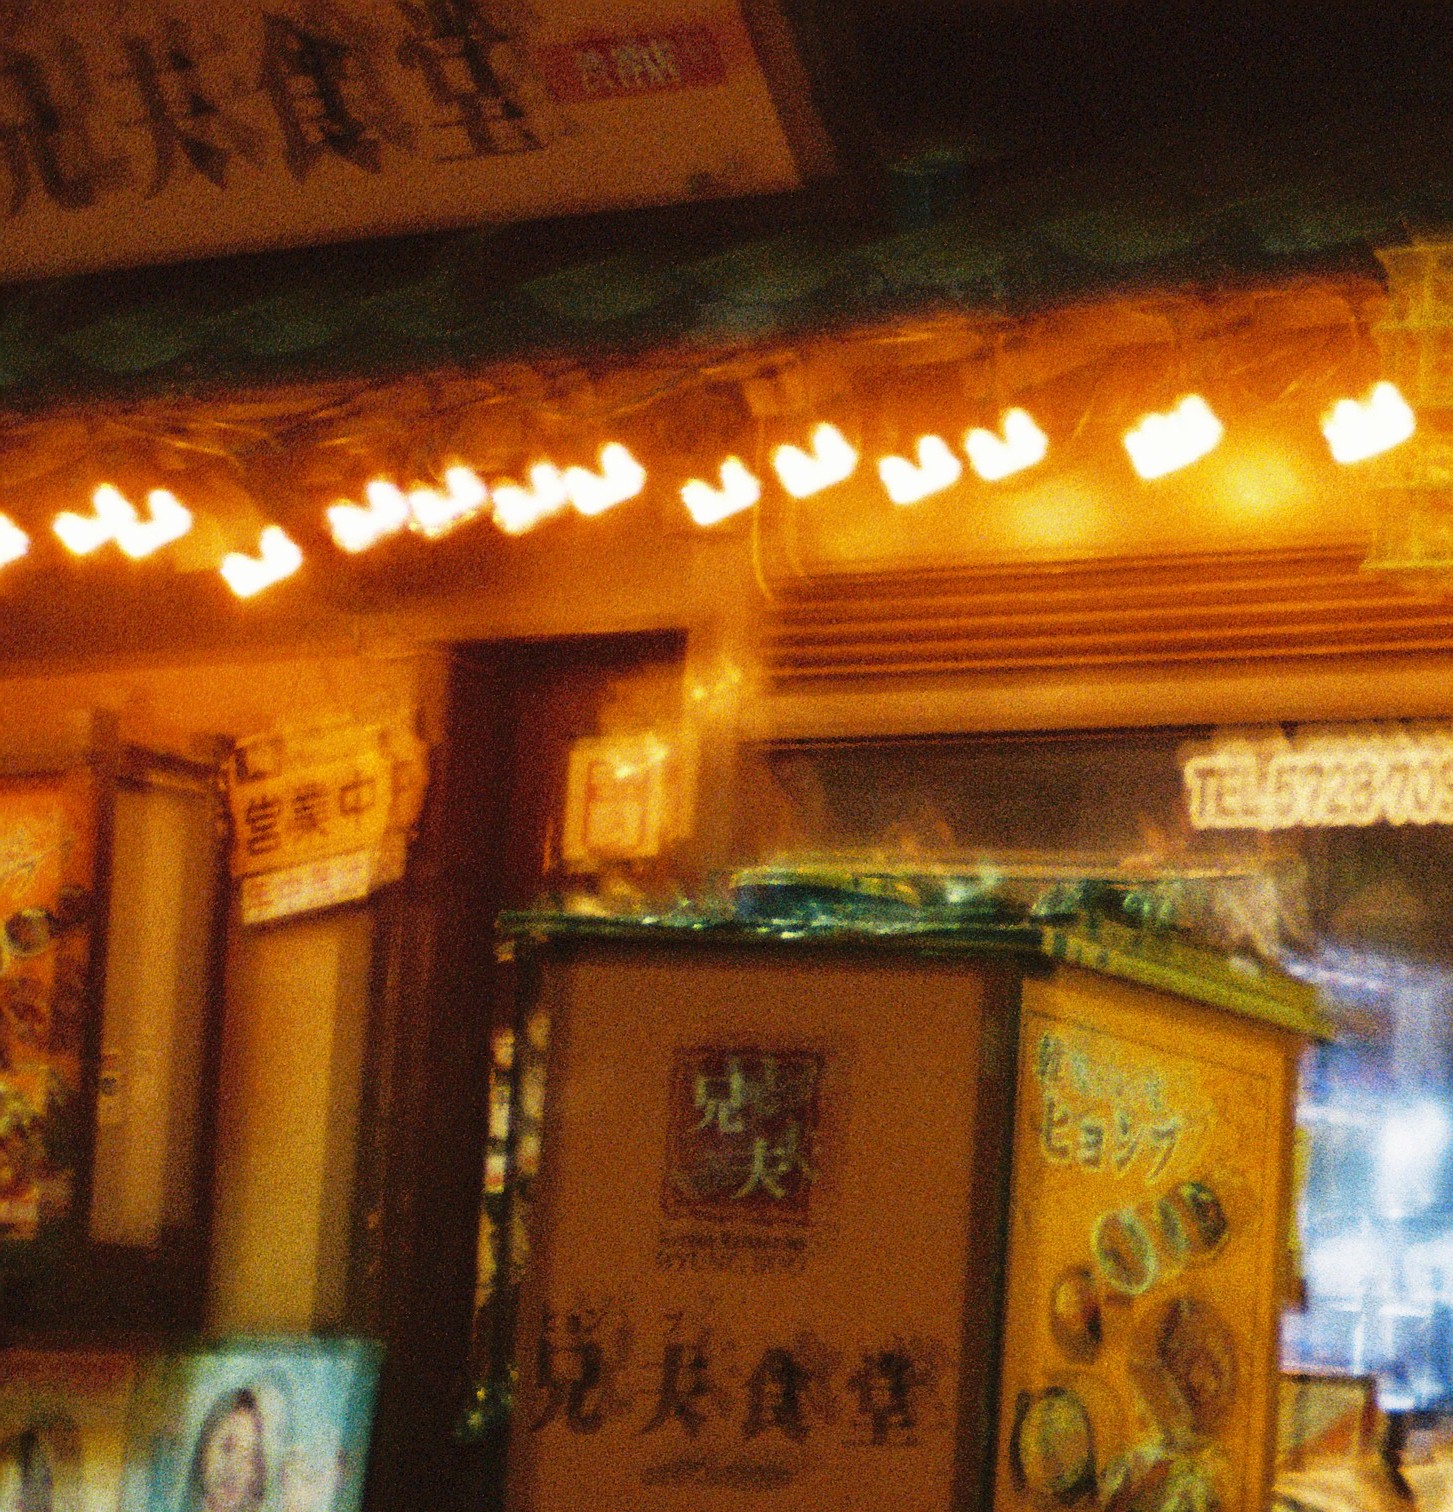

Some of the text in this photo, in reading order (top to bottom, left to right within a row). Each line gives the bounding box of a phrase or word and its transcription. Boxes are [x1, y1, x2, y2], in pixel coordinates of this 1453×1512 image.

[1196, 766, 1261, 817] TEL
[527, 1325, 932, 1450] 兄夫食堂
